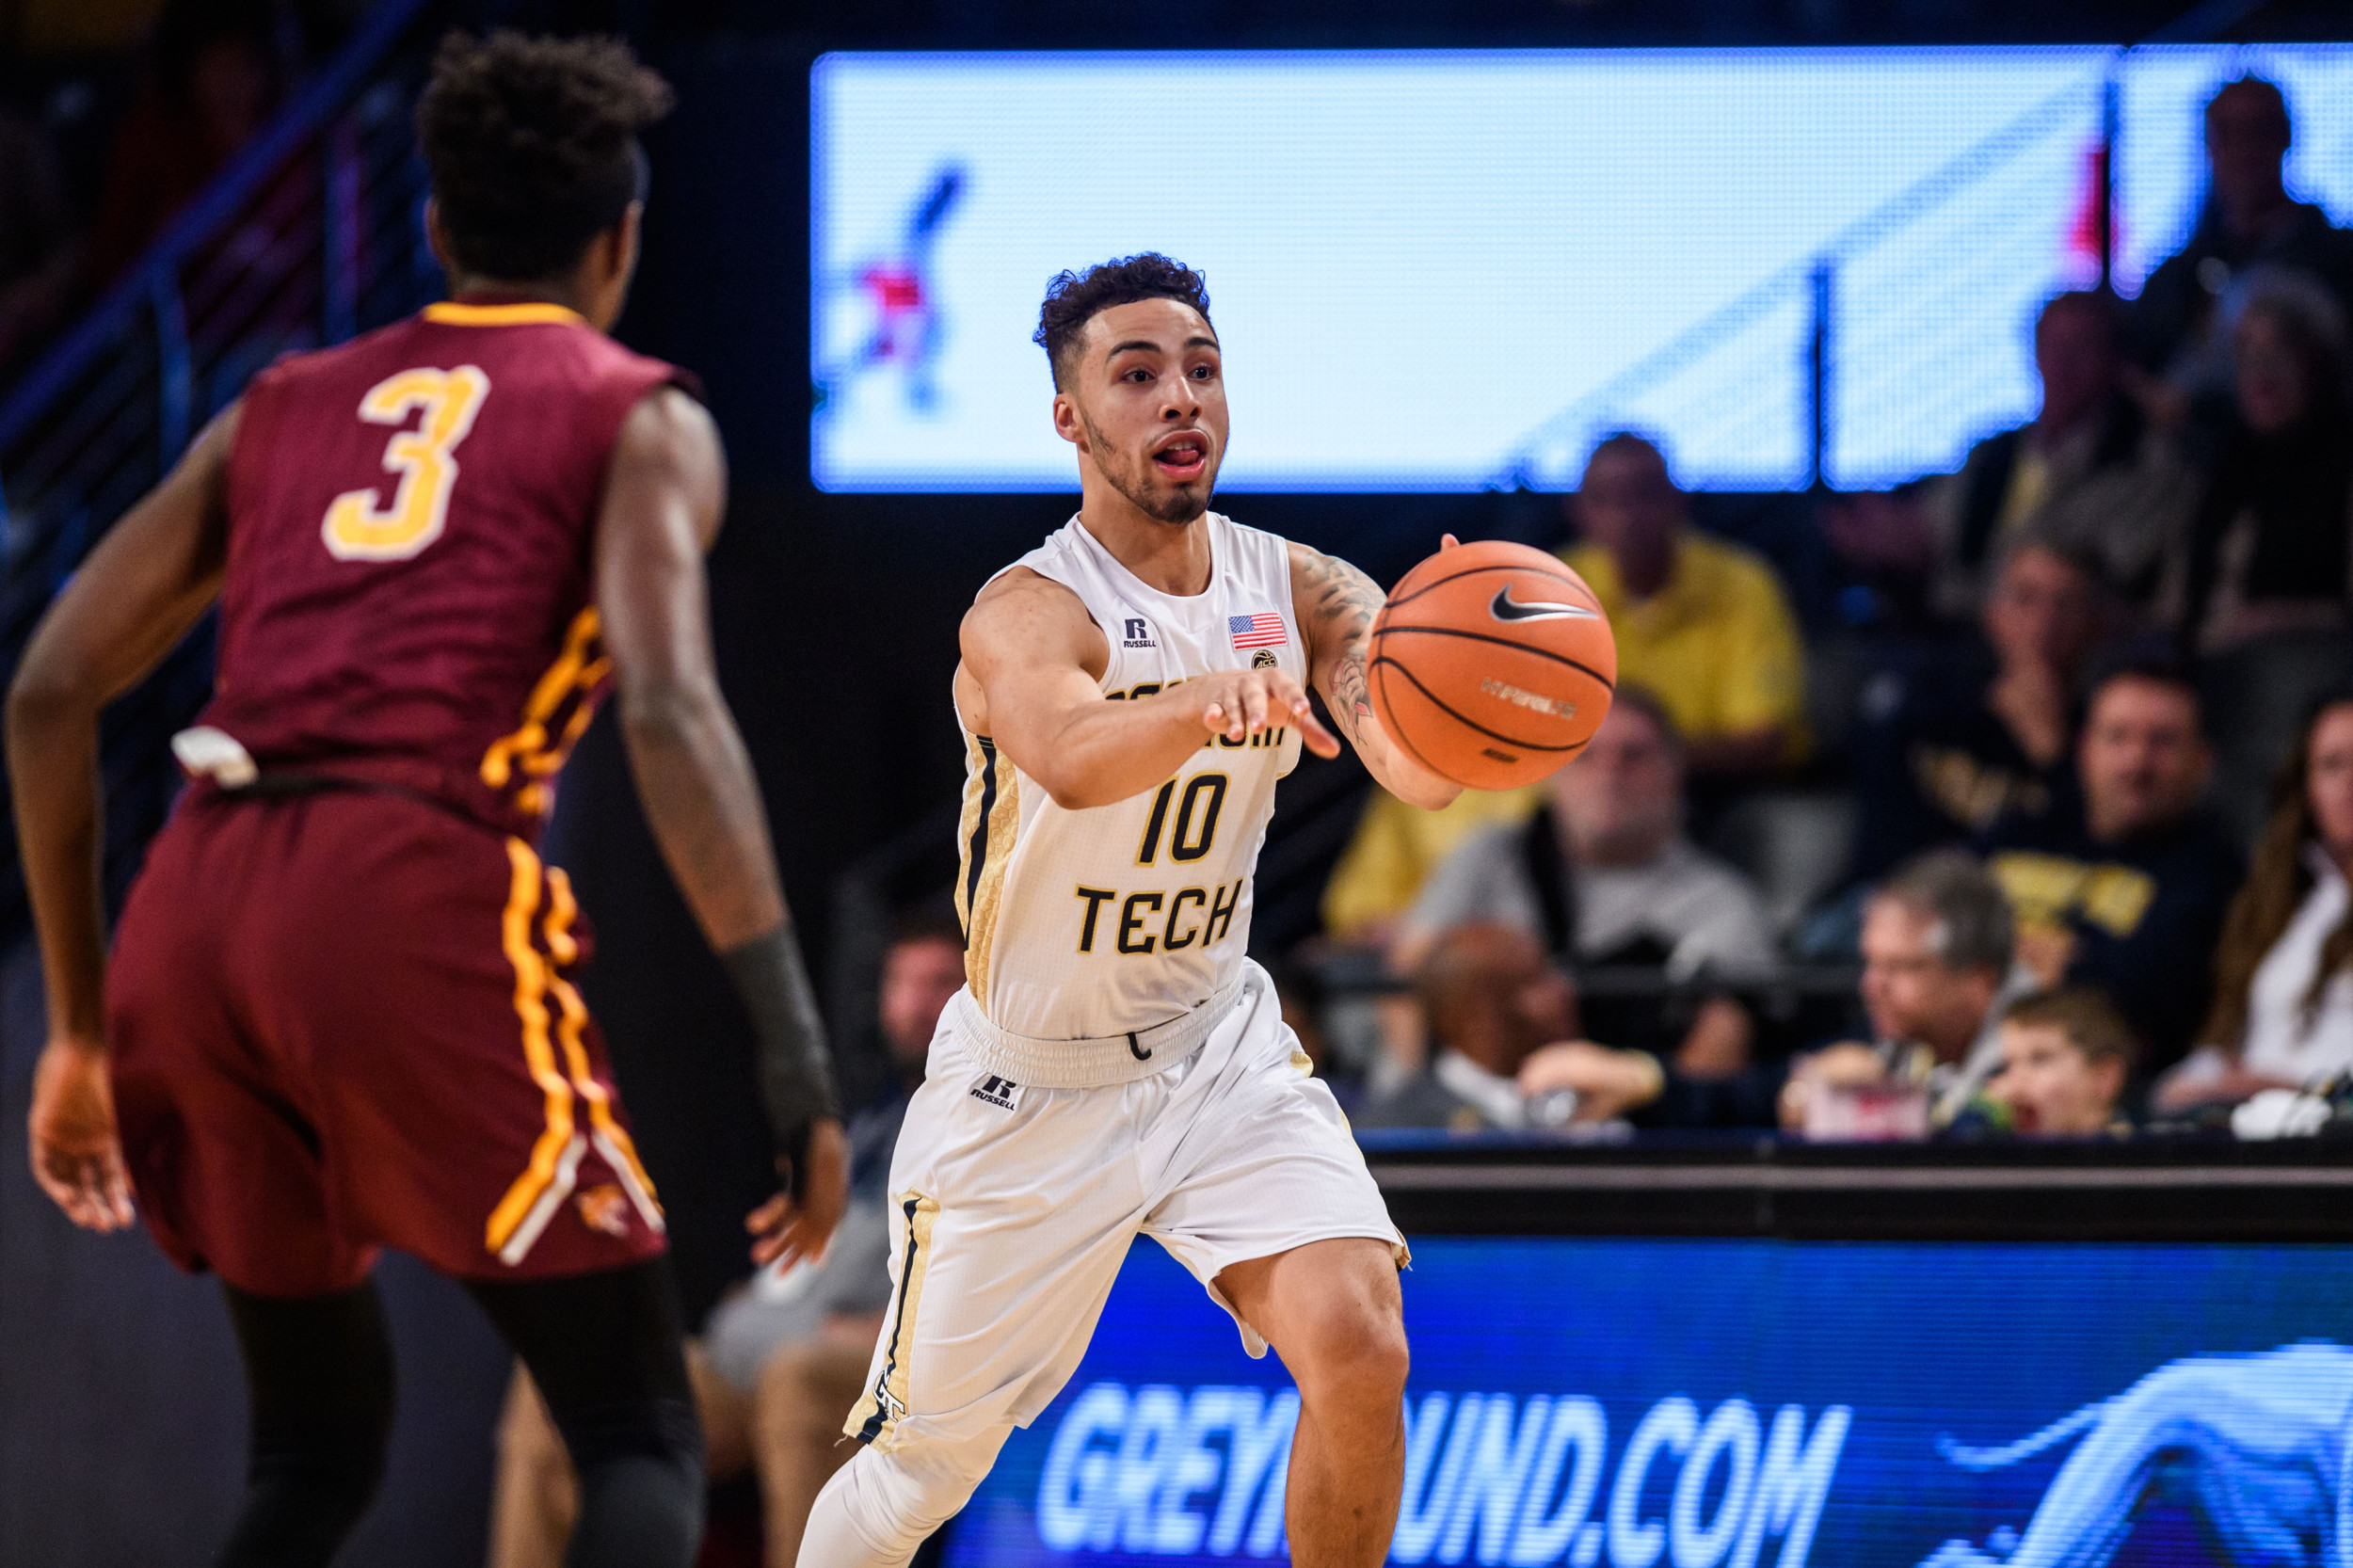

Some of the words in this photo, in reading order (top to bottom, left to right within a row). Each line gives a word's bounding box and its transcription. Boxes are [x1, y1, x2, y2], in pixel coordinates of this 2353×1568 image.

[321, 364, 491, 562] 3
[1123, 640, 1157, 648] RUSSELL
[1134, 771, 1230, 867] 10
[1075, 877, 1244, 956] TECH
[970, 1089, 1015, 1111] RUSSELL
[1036, 1381, 1853, 1568] GREYUND.COM
